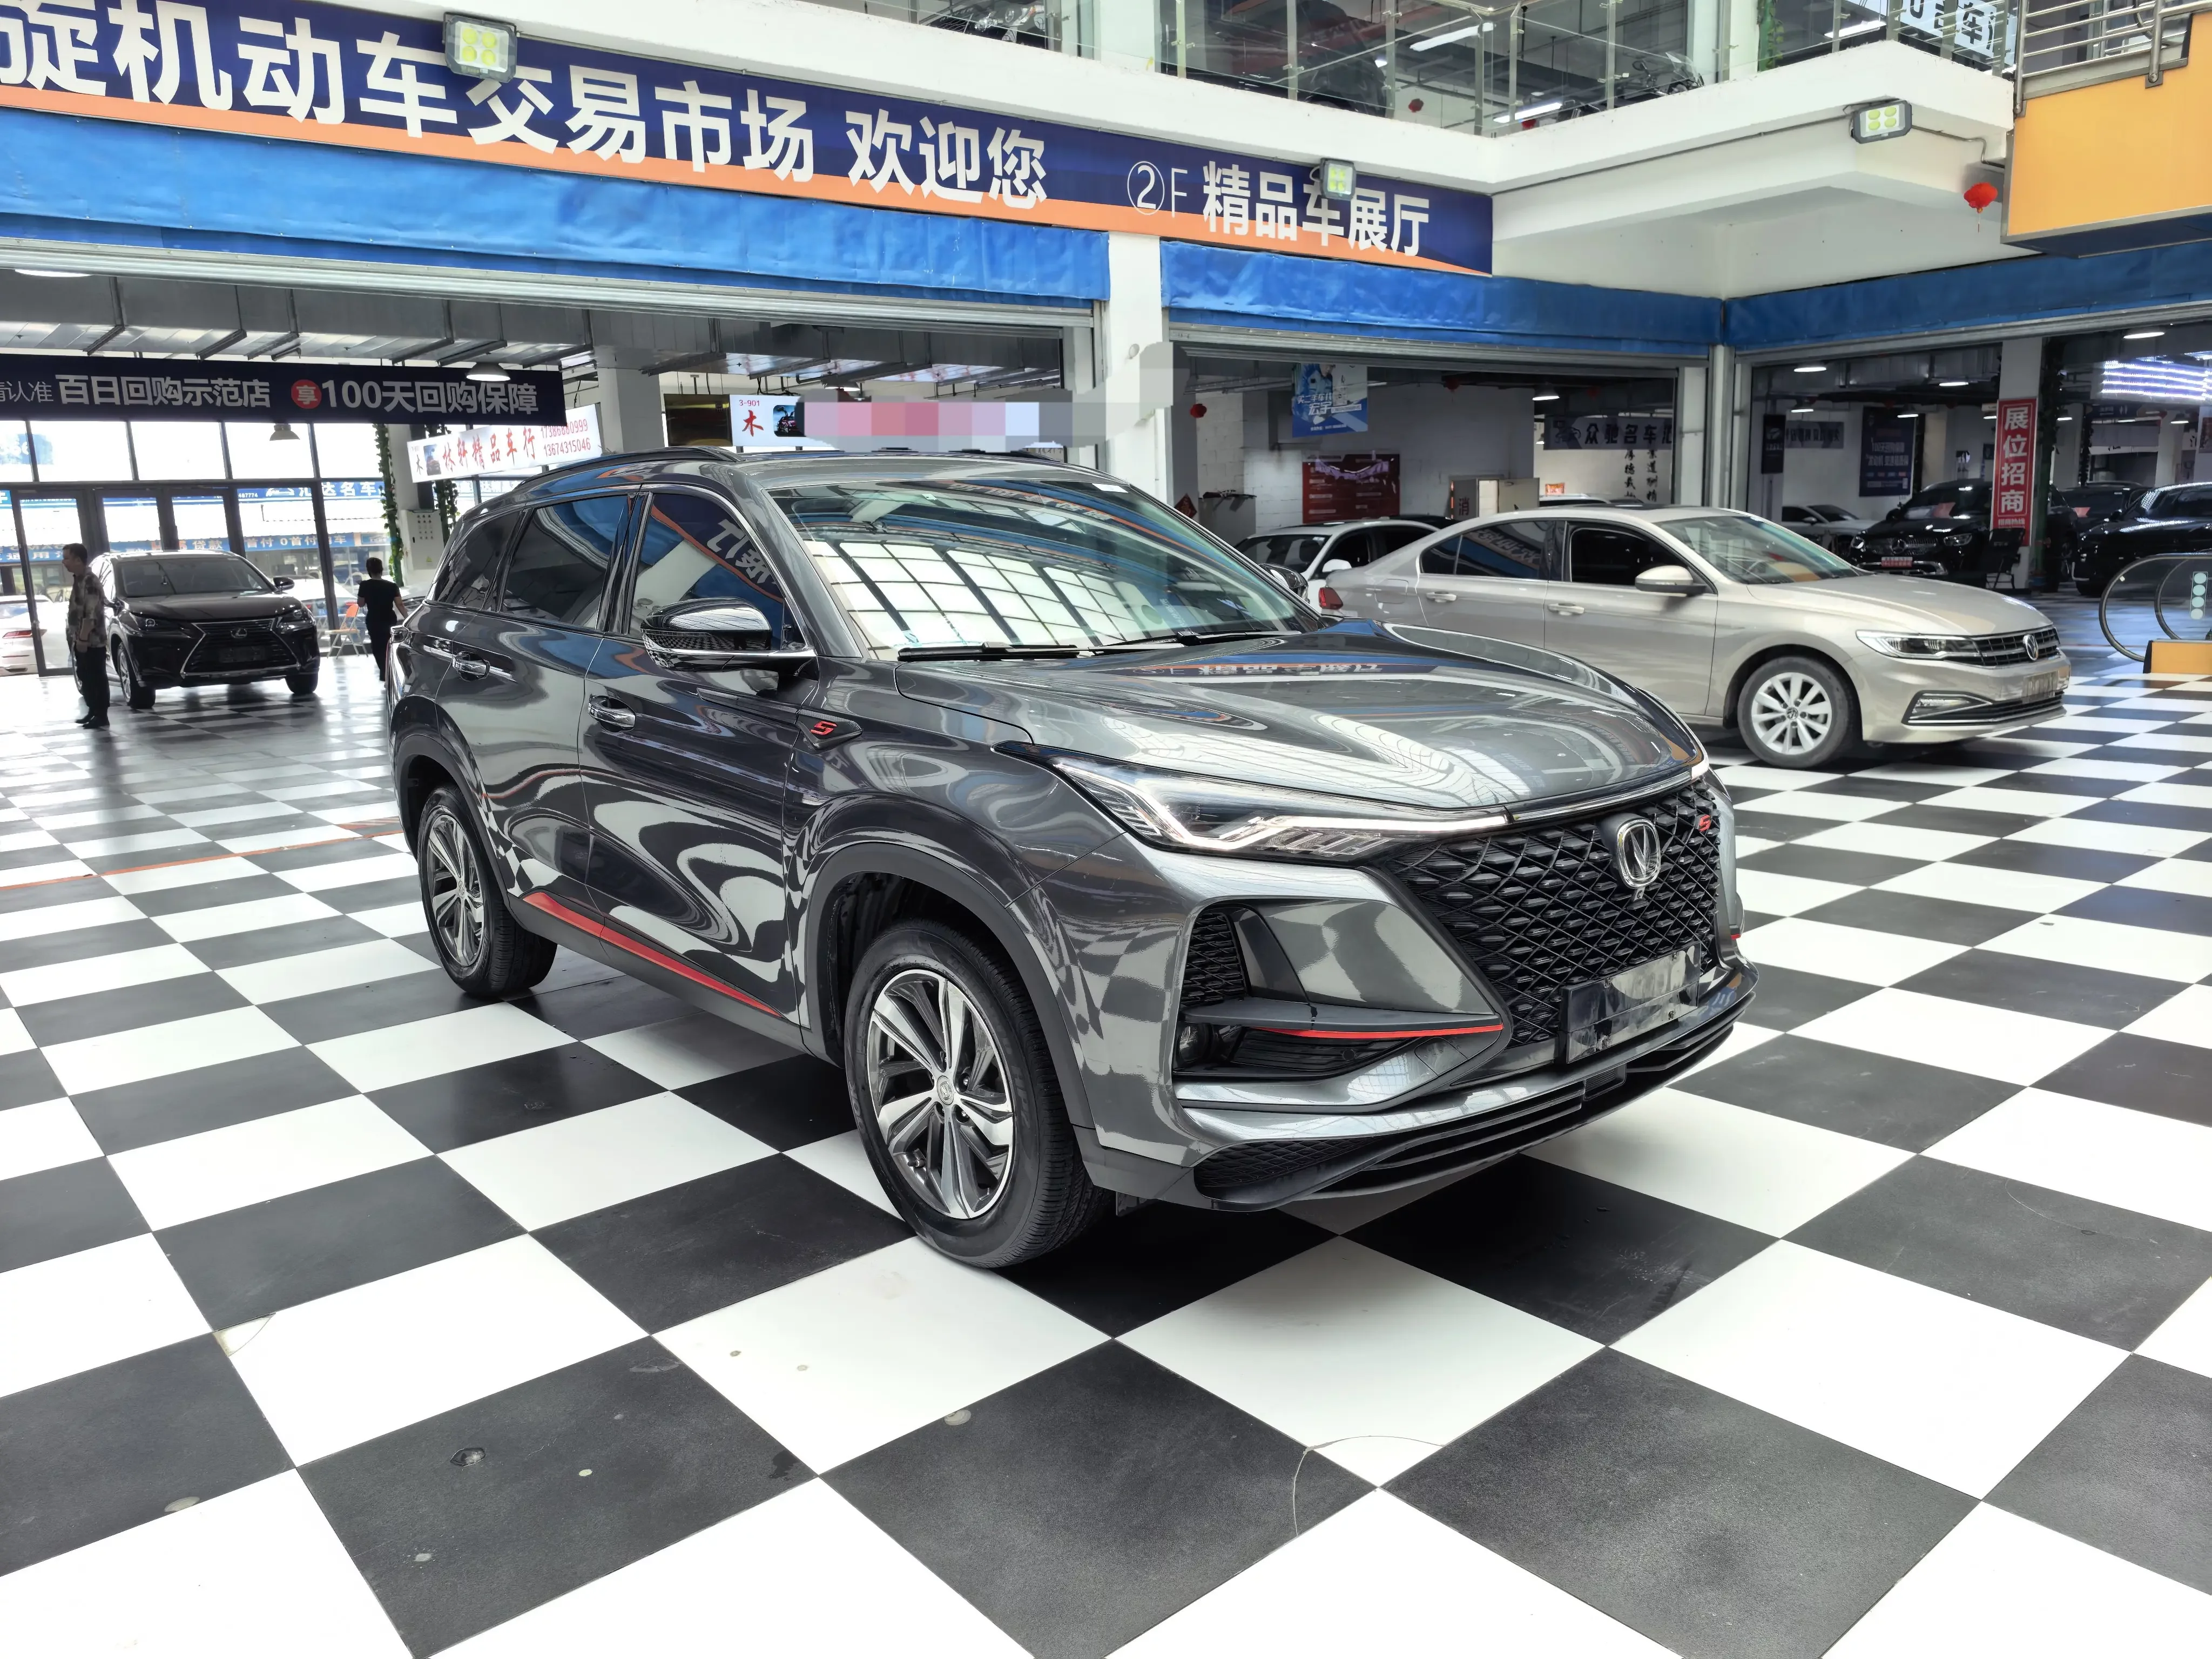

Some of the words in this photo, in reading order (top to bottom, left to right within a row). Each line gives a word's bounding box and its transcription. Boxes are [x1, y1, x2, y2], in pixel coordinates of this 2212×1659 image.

[846, 109, 1048, 210] 欢迎您
[1203, 160, 1429, 257] 精品车展厅
[55, 374, 271, 408] 百日回购示范店
[296, 385, 318, 406] 享
[322, 380, 538, 415] 100天回购保障
[742, 409, 764, 437] 木
[544, 437, 591, 457] 13674315046
[2000, 406, 2029, 513] 展位招商
[280, 535, 347, 547] 0首付车
